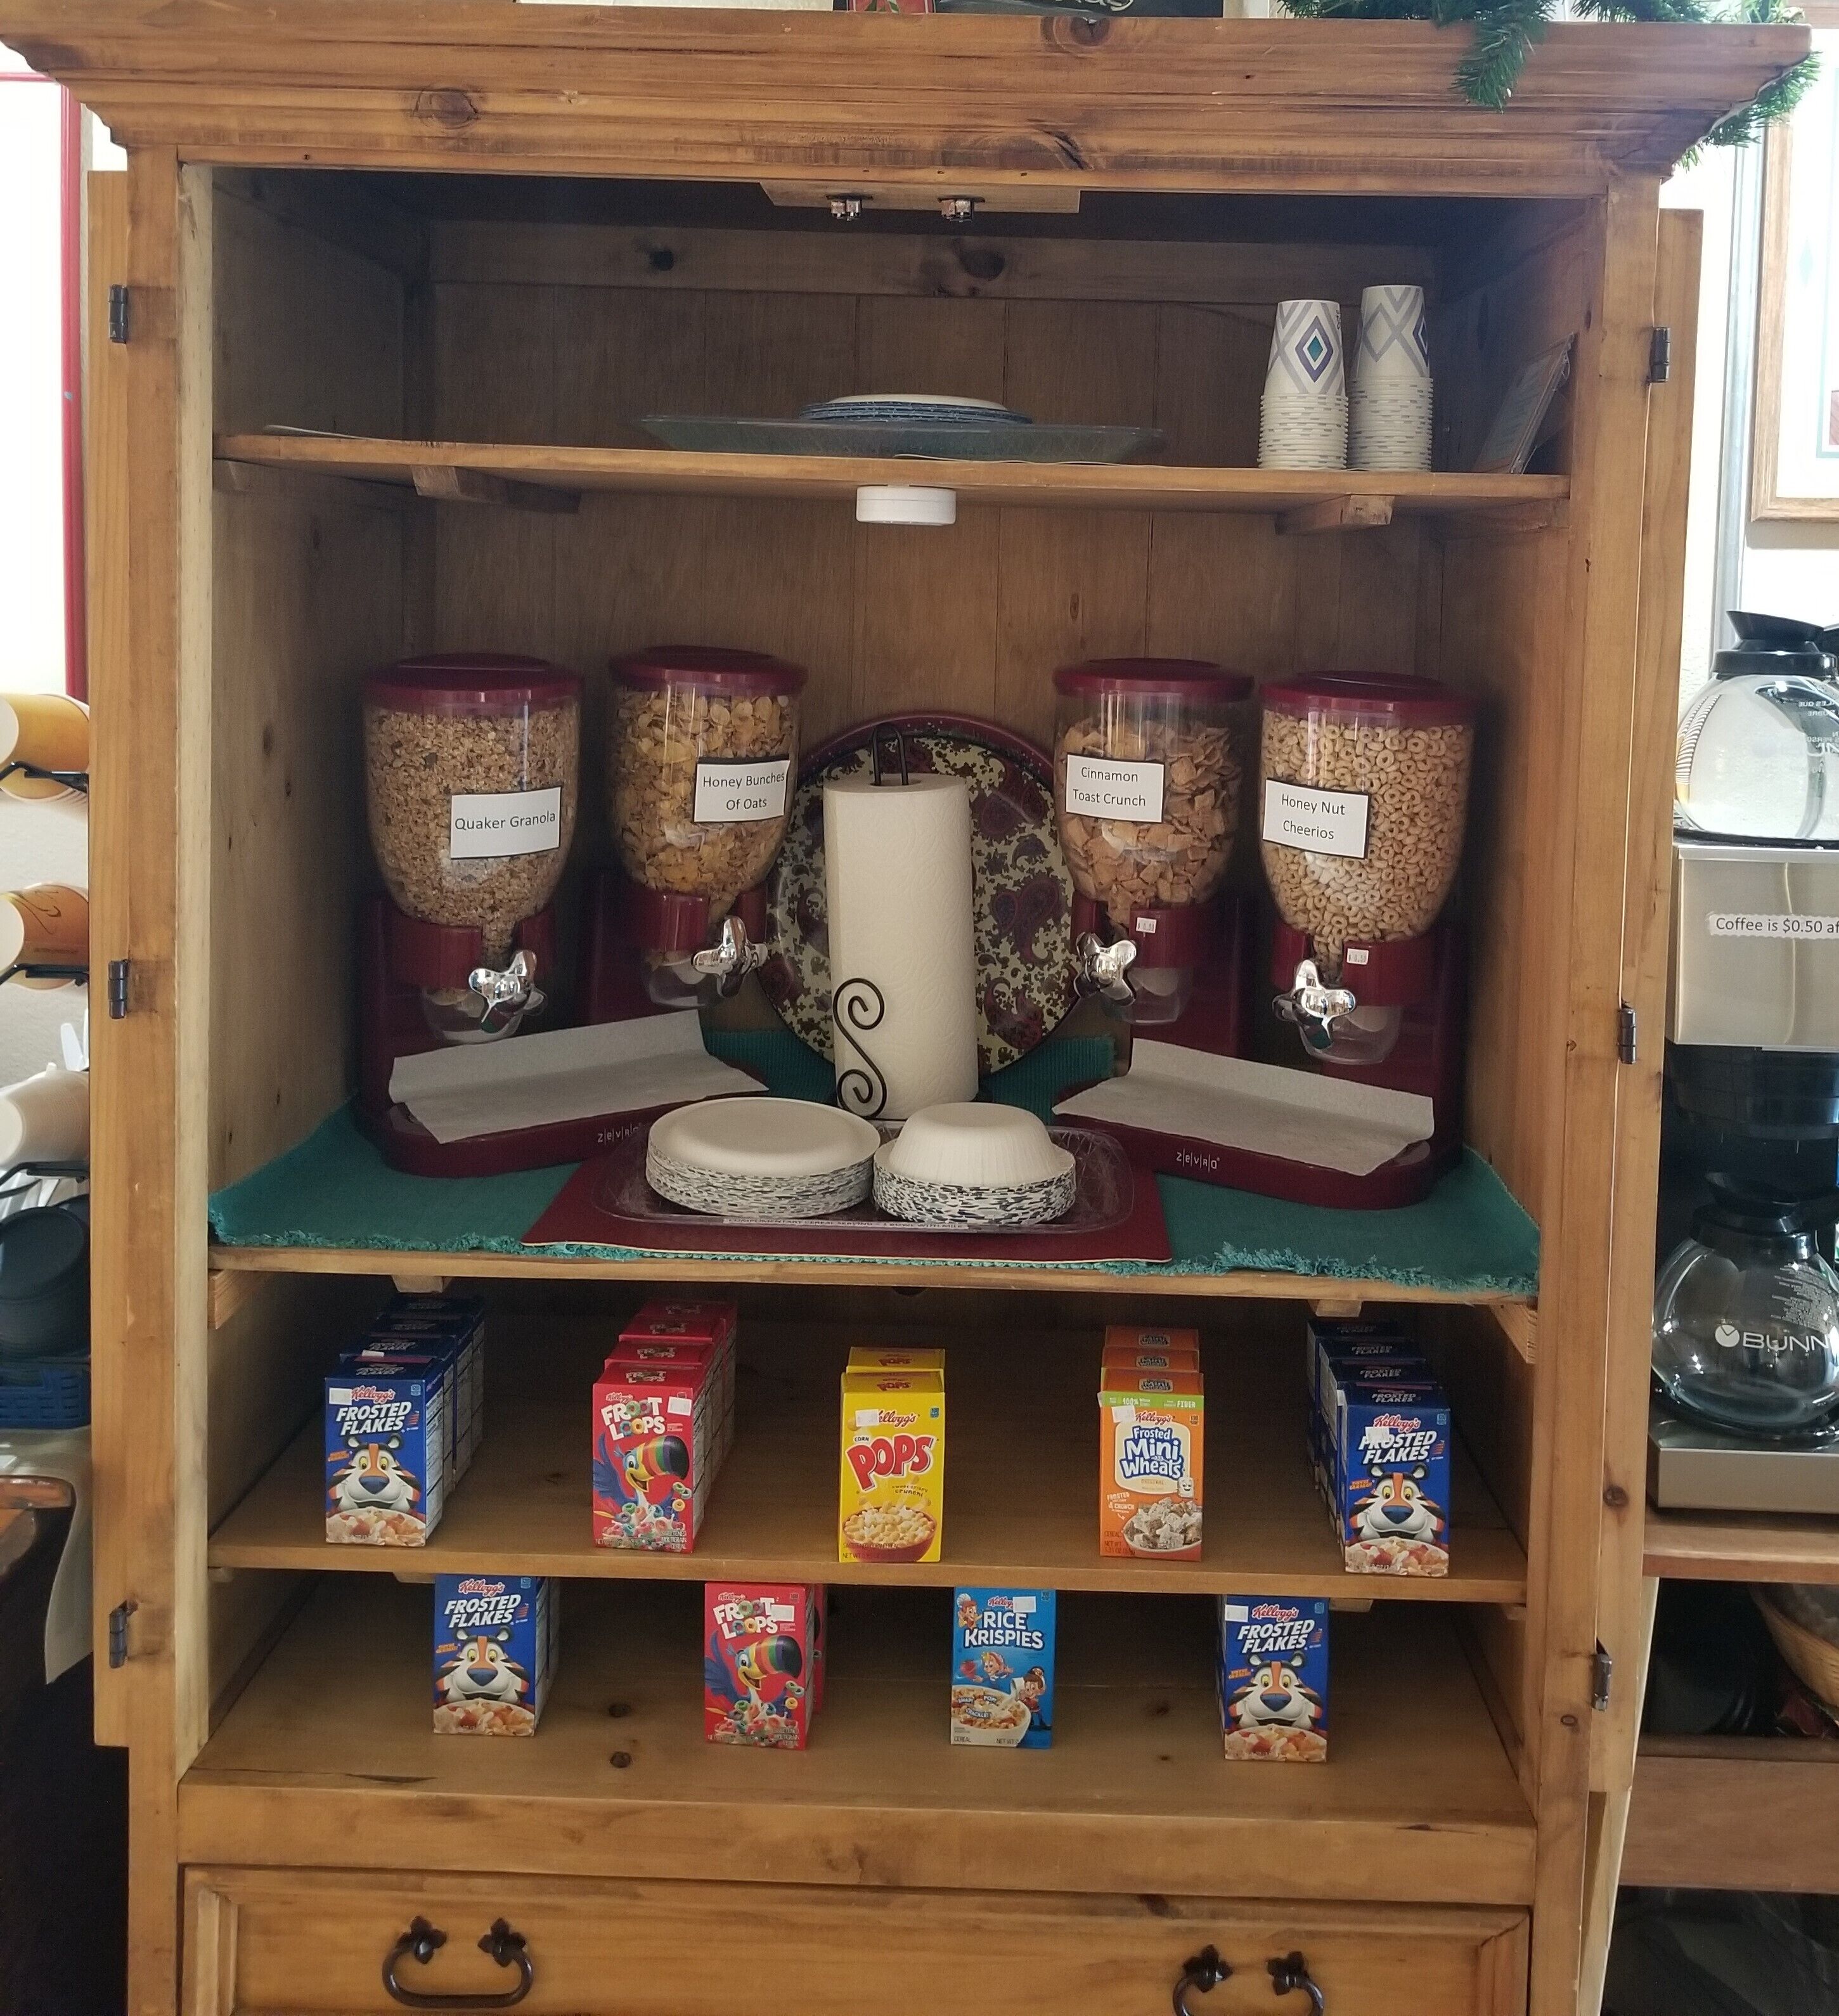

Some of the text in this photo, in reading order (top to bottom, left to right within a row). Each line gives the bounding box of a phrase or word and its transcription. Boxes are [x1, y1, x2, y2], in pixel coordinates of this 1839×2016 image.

[702, 772, 785, 789] Honey Bunches
[1081, 766, 1139, 782] Cinnamon
[726, 798, 767, 810] Of Oats
[1073, 788, 1146, 806] Toast Crunch
[1281, 793, 1346, 815] Honey Nut
[455, 810, 556, 830] Quaker Granola
[1282, 820, 1334, 840] Cheerios
[1715, 917, 1763, 931] Coffee
[1767, 919, 1778, 931] is
[1783, 918, 1823, 933] $0.50
[1743, 1331, 1829, 1352] BUNN
[352, 1385, 396, 1404] Kellogg's
[336, 1402, 412, 1422] FROSTED
[601, 1397, 662, 1426] FROOT
[879, 1409, 917, 1427] ellogg's
[1135, 1411, 1171, 1425] Kellogg's
[340, 1416, 405, 1436] FLAKES
[609, 1416, 666, 1441] LOOPS
[1132, 1426, 1171, 1440] Frosted
[1374, 1413, 1421, 1433] Kellogg's
[1125, 1438, 1179, 1461] Mini
[1362, 1445, 1430, 1464] FLAKES
[845, 1433, 934, 1492] POPS
[1120, 1456, 1183, 1479] Wheats
[458, 1579, 505, 1597] Kellogg's
[444, 1594, 521, 1615] FROSTED
[713, 1597, 775, 1625] FROOT
[1252, 1603, 1299, 1622] Kellogg's
[448, 1608, 515, 1628] FLAKES
[721, 1616, 778, 1639] LOOPS
[983, 1610, 1027, 1630] RICE
[964, 1628, 1043, 1649] KRISPIES
[1237, 1619, 1315, 1640] FROSTED
[1241, 1634, 1308, 1654] FLAKES
